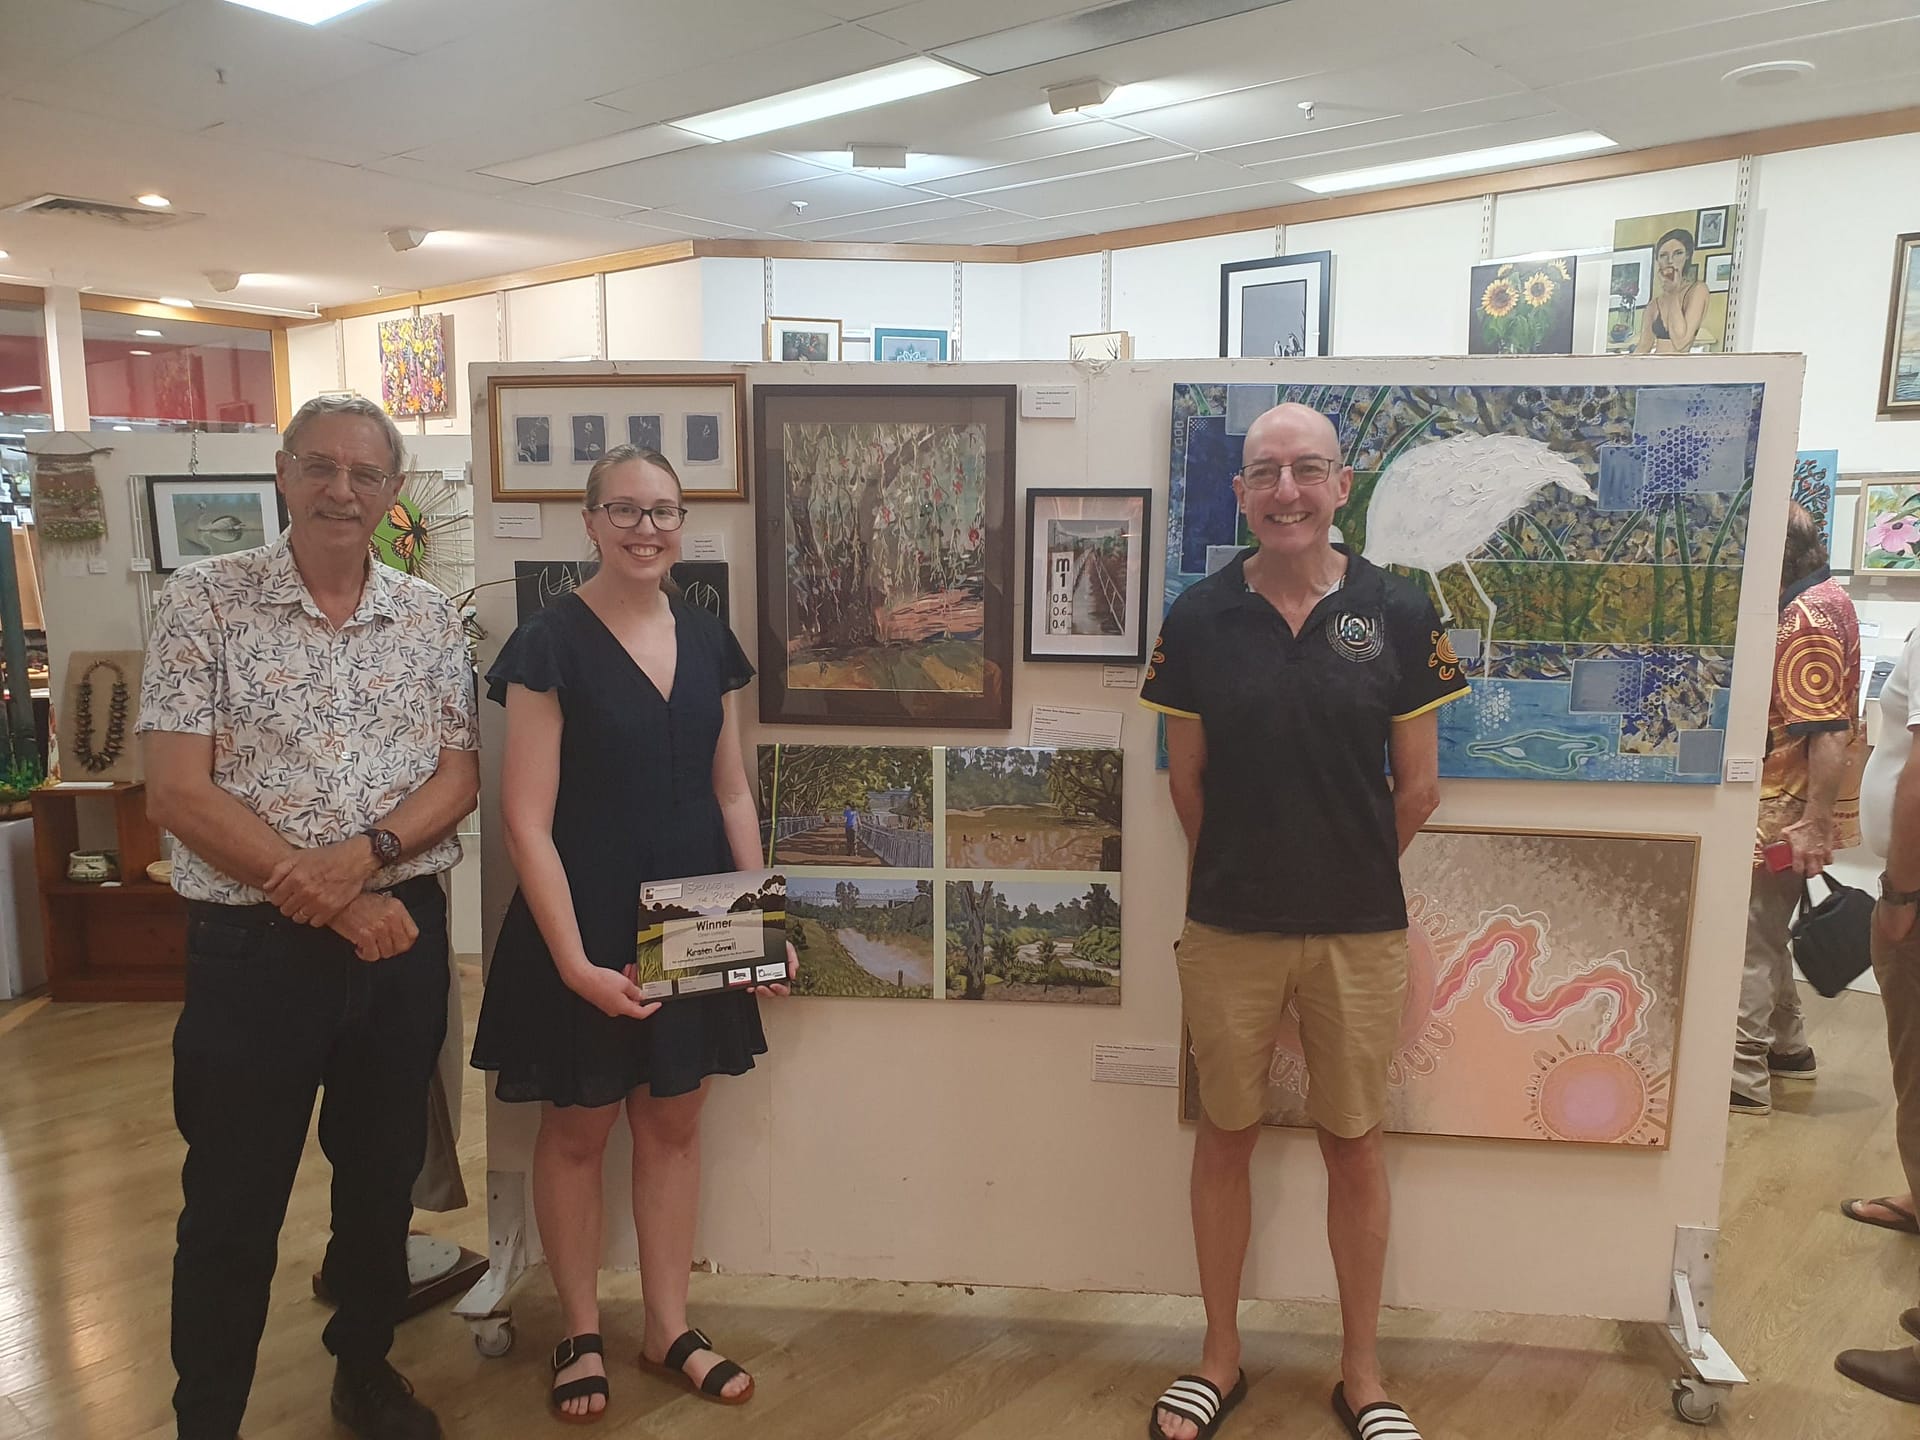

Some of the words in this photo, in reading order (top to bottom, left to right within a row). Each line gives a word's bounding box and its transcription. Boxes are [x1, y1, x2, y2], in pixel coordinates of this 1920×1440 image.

[1055, 558, 1070, 572] m
[1060, 573, 1066, 587] 1
[696, 919, 732, 931] Winner
